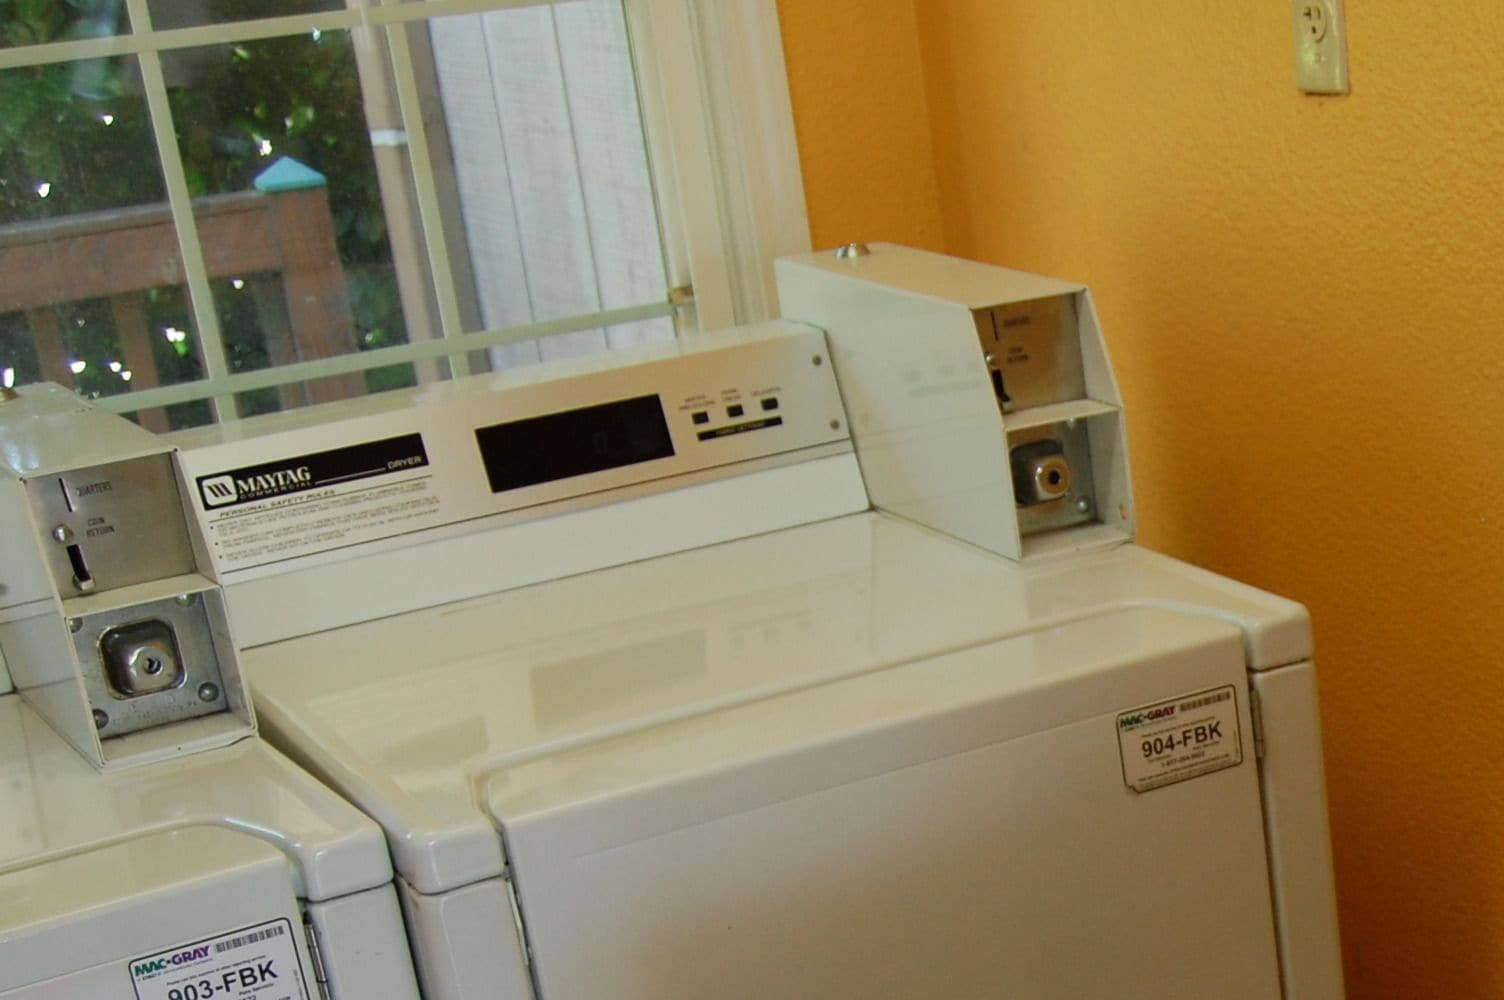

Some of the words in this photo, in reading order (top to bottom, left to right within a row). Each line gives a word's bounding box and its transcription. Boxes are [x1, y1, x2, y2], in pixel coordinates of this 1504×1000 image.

[387, 455, 422, 470] DRYER
[236, 466, 311, 494] MAYTAG
[240, 481, 312, 500] COMMERCIAL
[220, 504, 267, 518] PERSONAL
[270, 496, 304, 507] SAFETY
[1142, 720, 1222, 758] 904-FBK
[134, 945, 210, 977] MAC-GRAY
